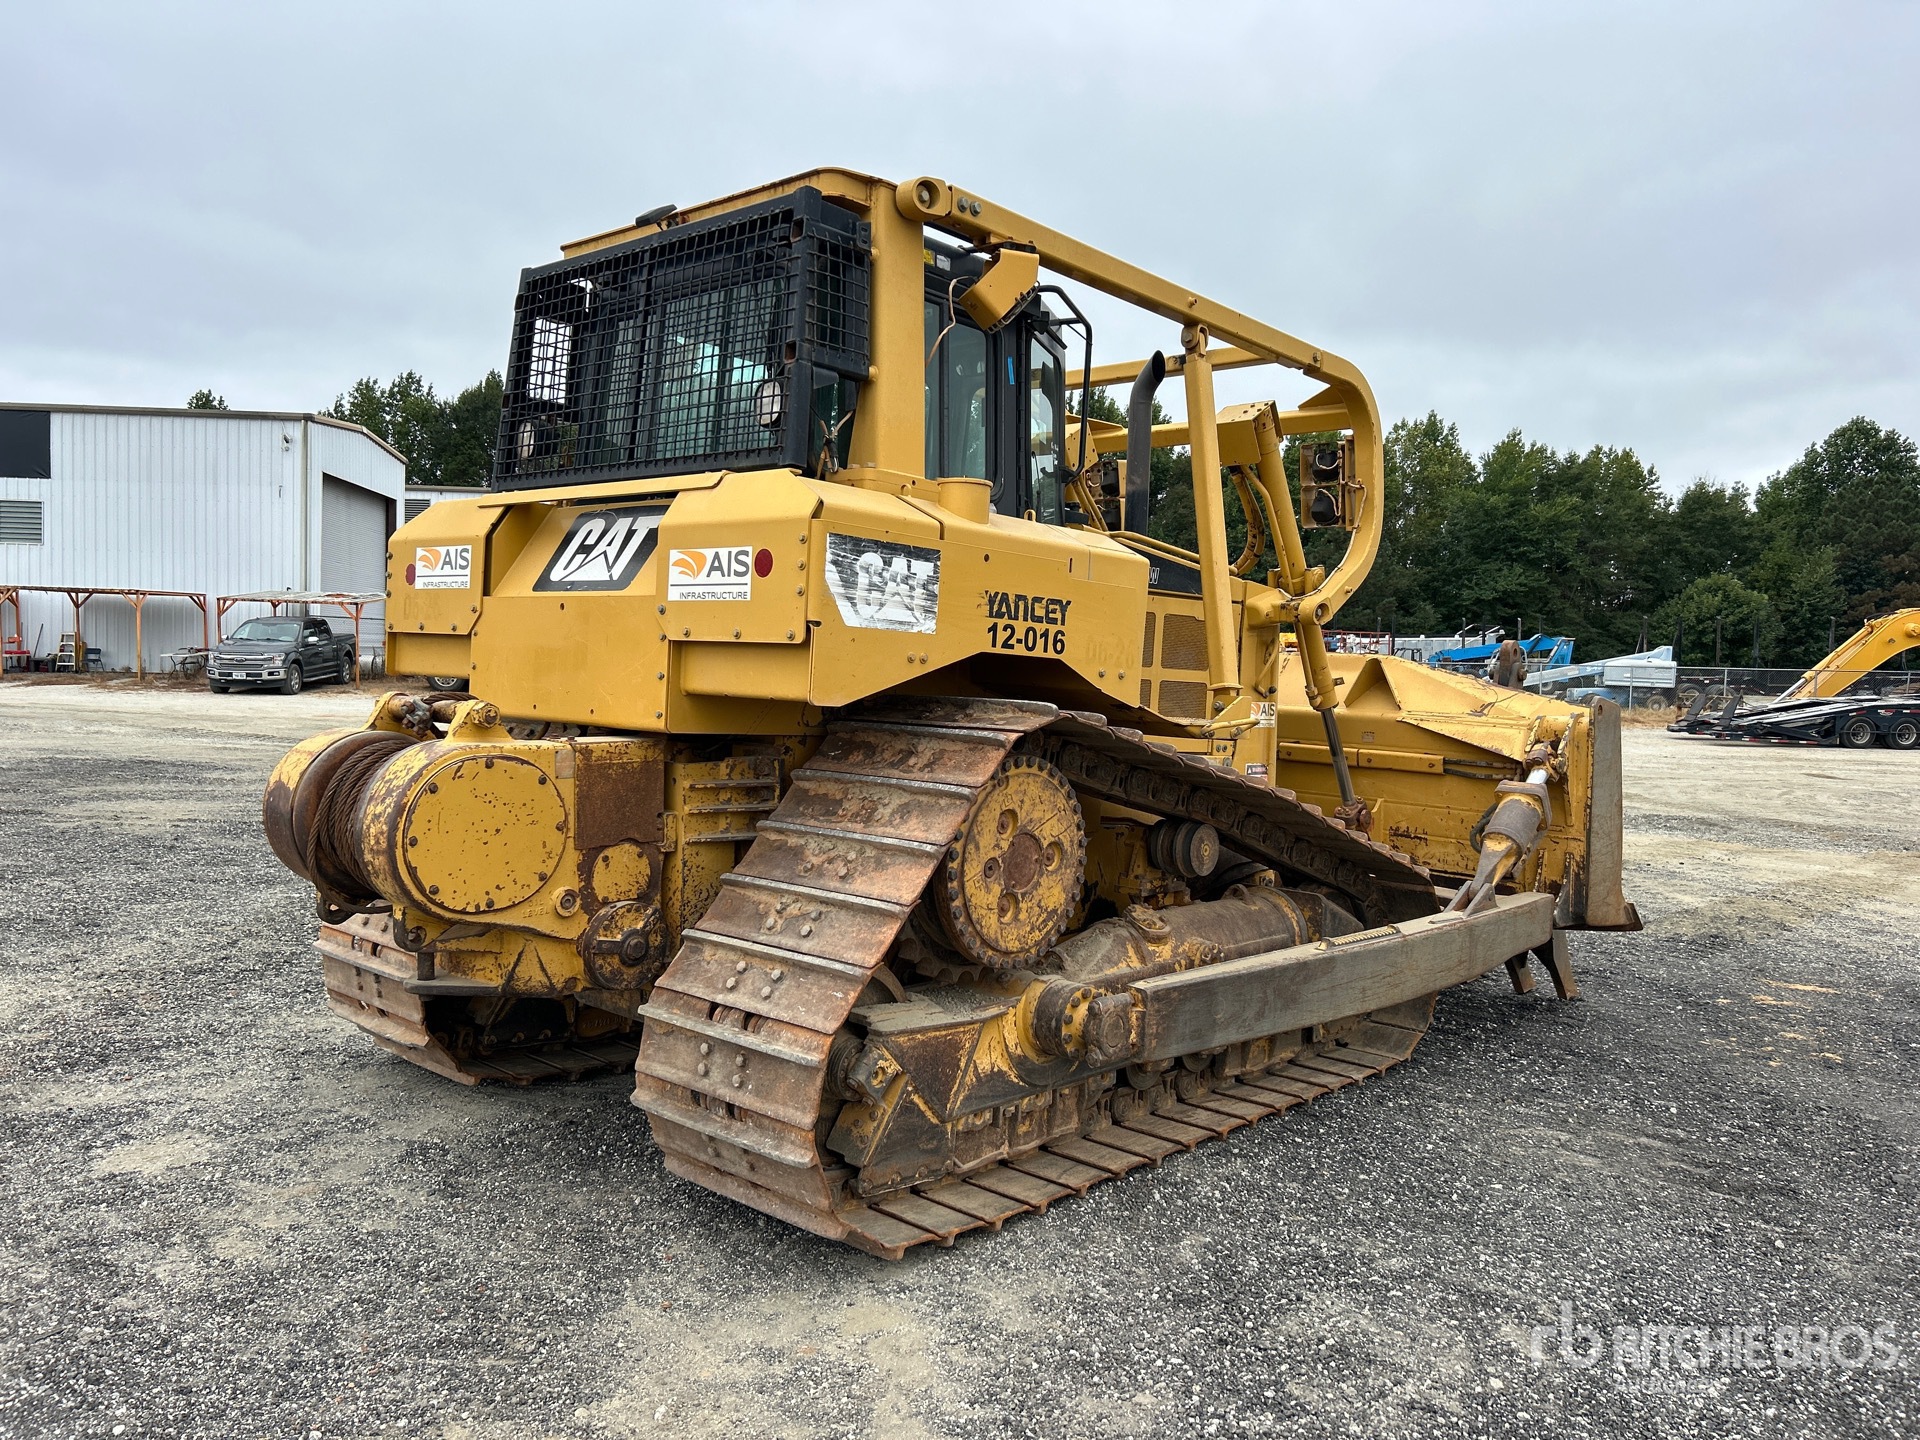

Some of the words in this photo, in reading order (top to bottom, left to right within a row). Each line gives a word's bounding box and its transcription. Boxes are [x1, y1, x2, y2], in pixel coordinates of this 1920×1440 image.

[441, 547, 471, 571] AIS
[549, 518, 663, 582] CAT
[706, 549, 751, 578] AIS
[422, 580, 469, 588] INFRASTRUCTURE
[679, 591, 748, 600] INFRASTRUCTURE
[856, 552, 935, 622] CAT
[984, 590, 1072, 626] YANCEY
[987, 621, 1067, 655] 12-016
[1260, 703, 1275, 717] AIS
[523, 908, 550, 919] LEVEL
[529, 899, 544, 907] OIL
